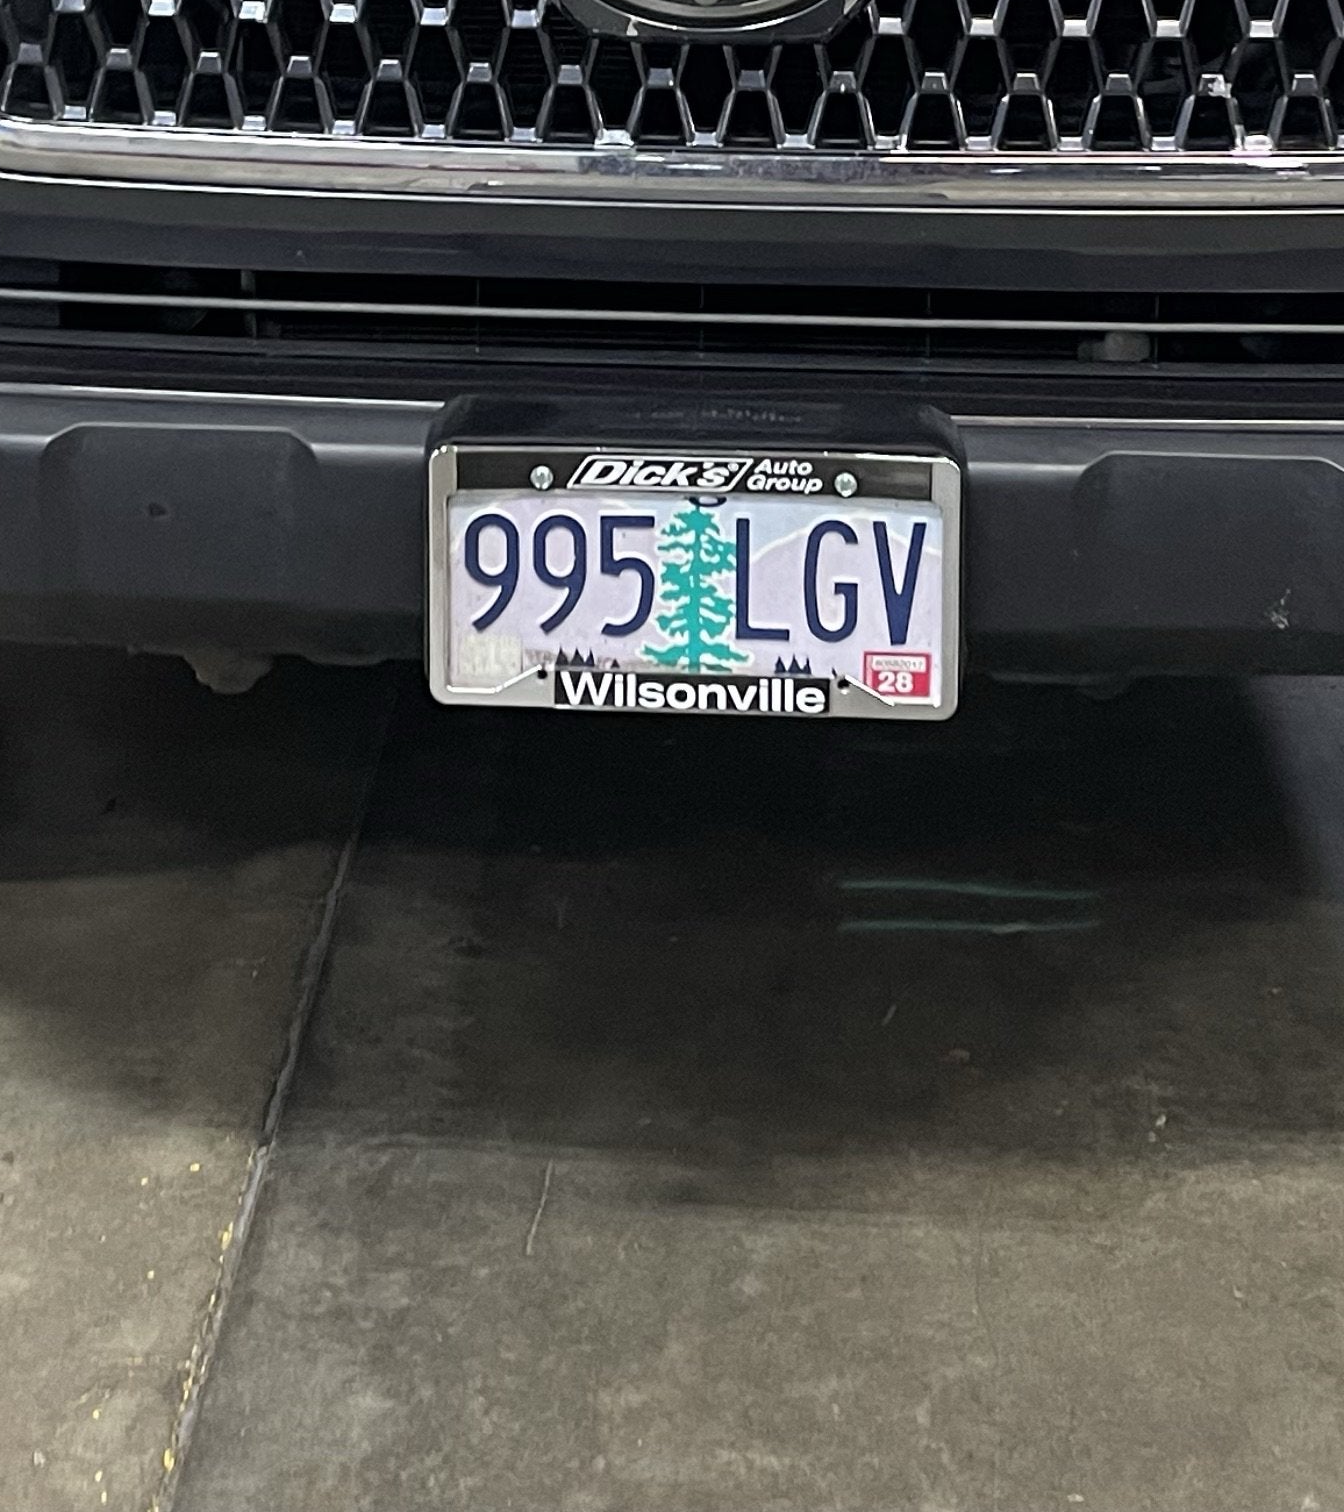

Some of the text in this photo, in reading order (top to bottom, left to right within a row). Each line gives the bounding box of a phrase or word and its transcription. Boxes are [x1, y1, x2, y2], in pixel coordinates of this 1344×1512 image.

[753, 458, 813, 476] Auto
[746, 474, 824, 494] Group
[464, 513, 928, 646] 995 LGV
[560, 671, 827, 713] Wilsonville
[877, 670, 914, 694] 28
